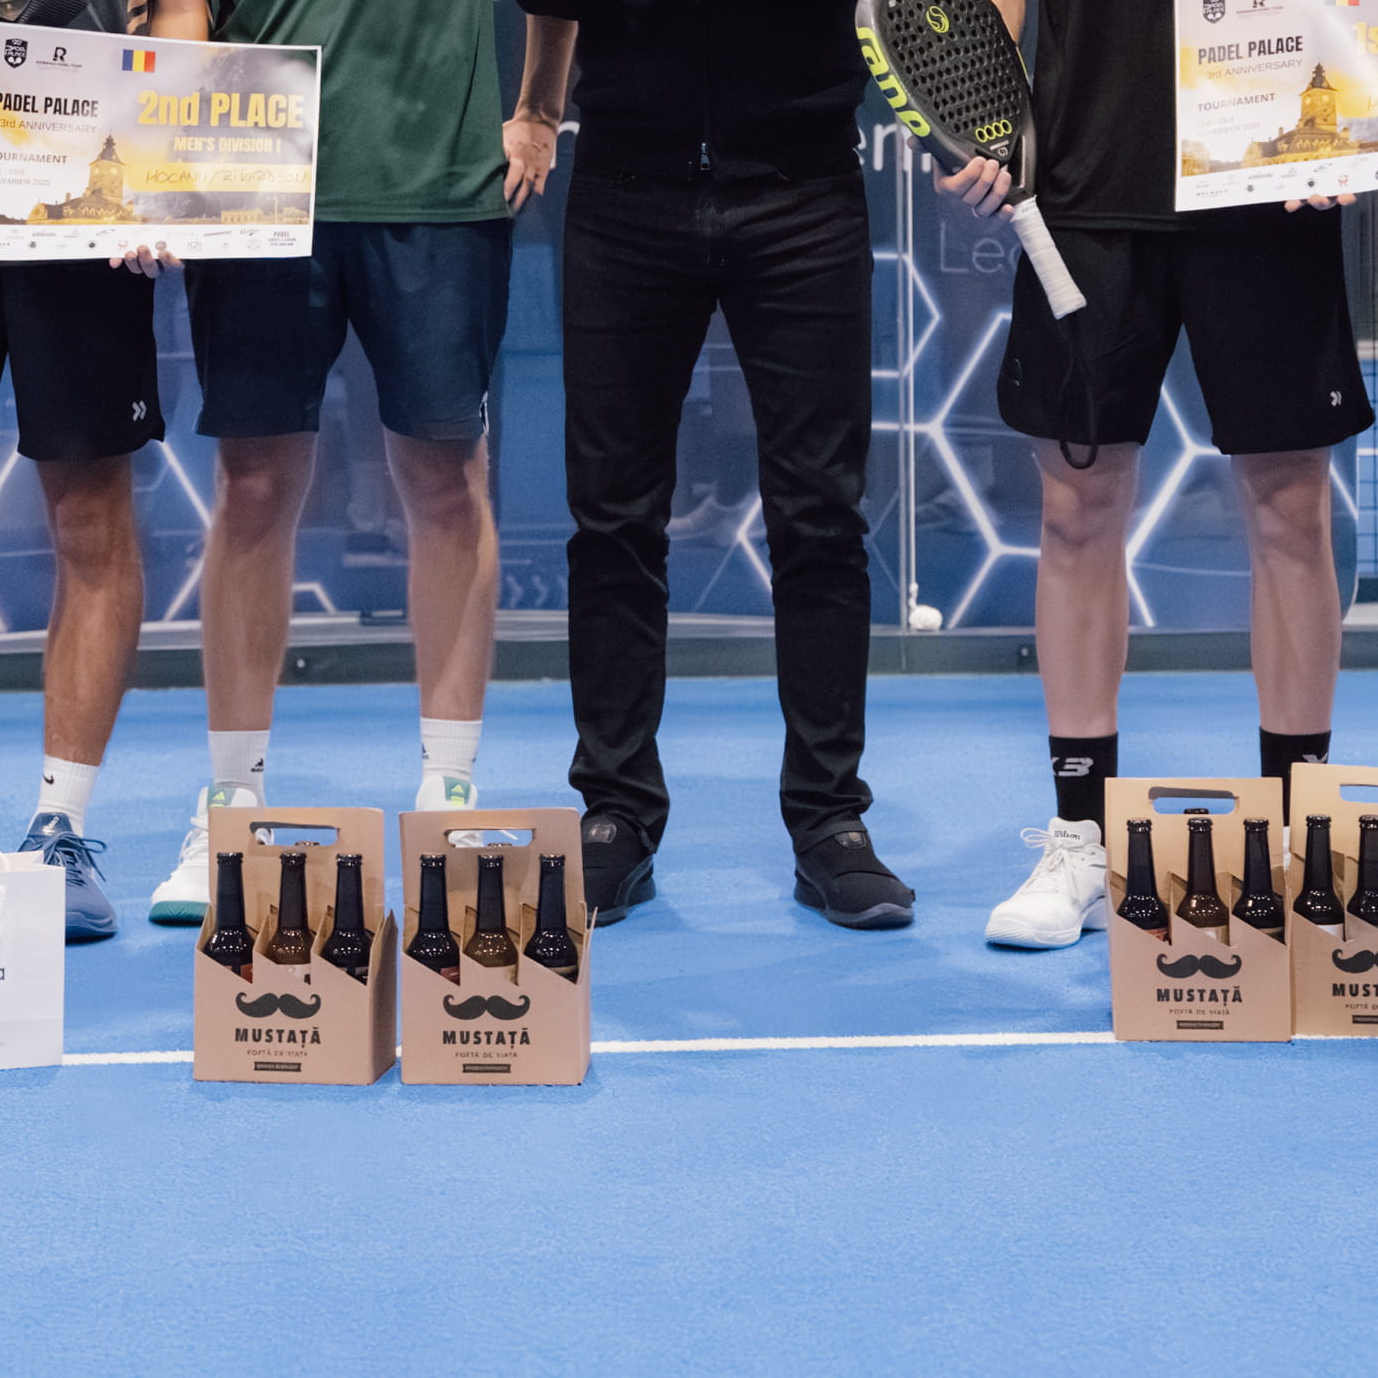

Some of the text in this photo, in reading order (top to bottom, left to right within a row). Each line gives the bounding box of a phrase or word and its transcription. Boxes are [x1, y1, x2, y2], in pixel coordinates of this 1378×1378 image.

[1198, 36, 1303, 65] PADEL PALACE
[1225, 59, 1303, 76] ANNIVERSARY
[44, 97, 99, 117] PALACE
[138, 90, 305, 128] 2nd PLACE
[1197, 93, 1276, 112] TOURNAMENT
[0, 119, 97, 133] 3rd ANNIVERSARY
[174, 137, 214, 151] MEN'S
[219, 138, 274, 152] DIVISION
[1157, 986, 1242, 1006] MUSTAȚĂ
[235, 1026, 321, 1048] MUSTAȚĂ
[443, 1027, 530, 1049] MUSTAȚĂ
